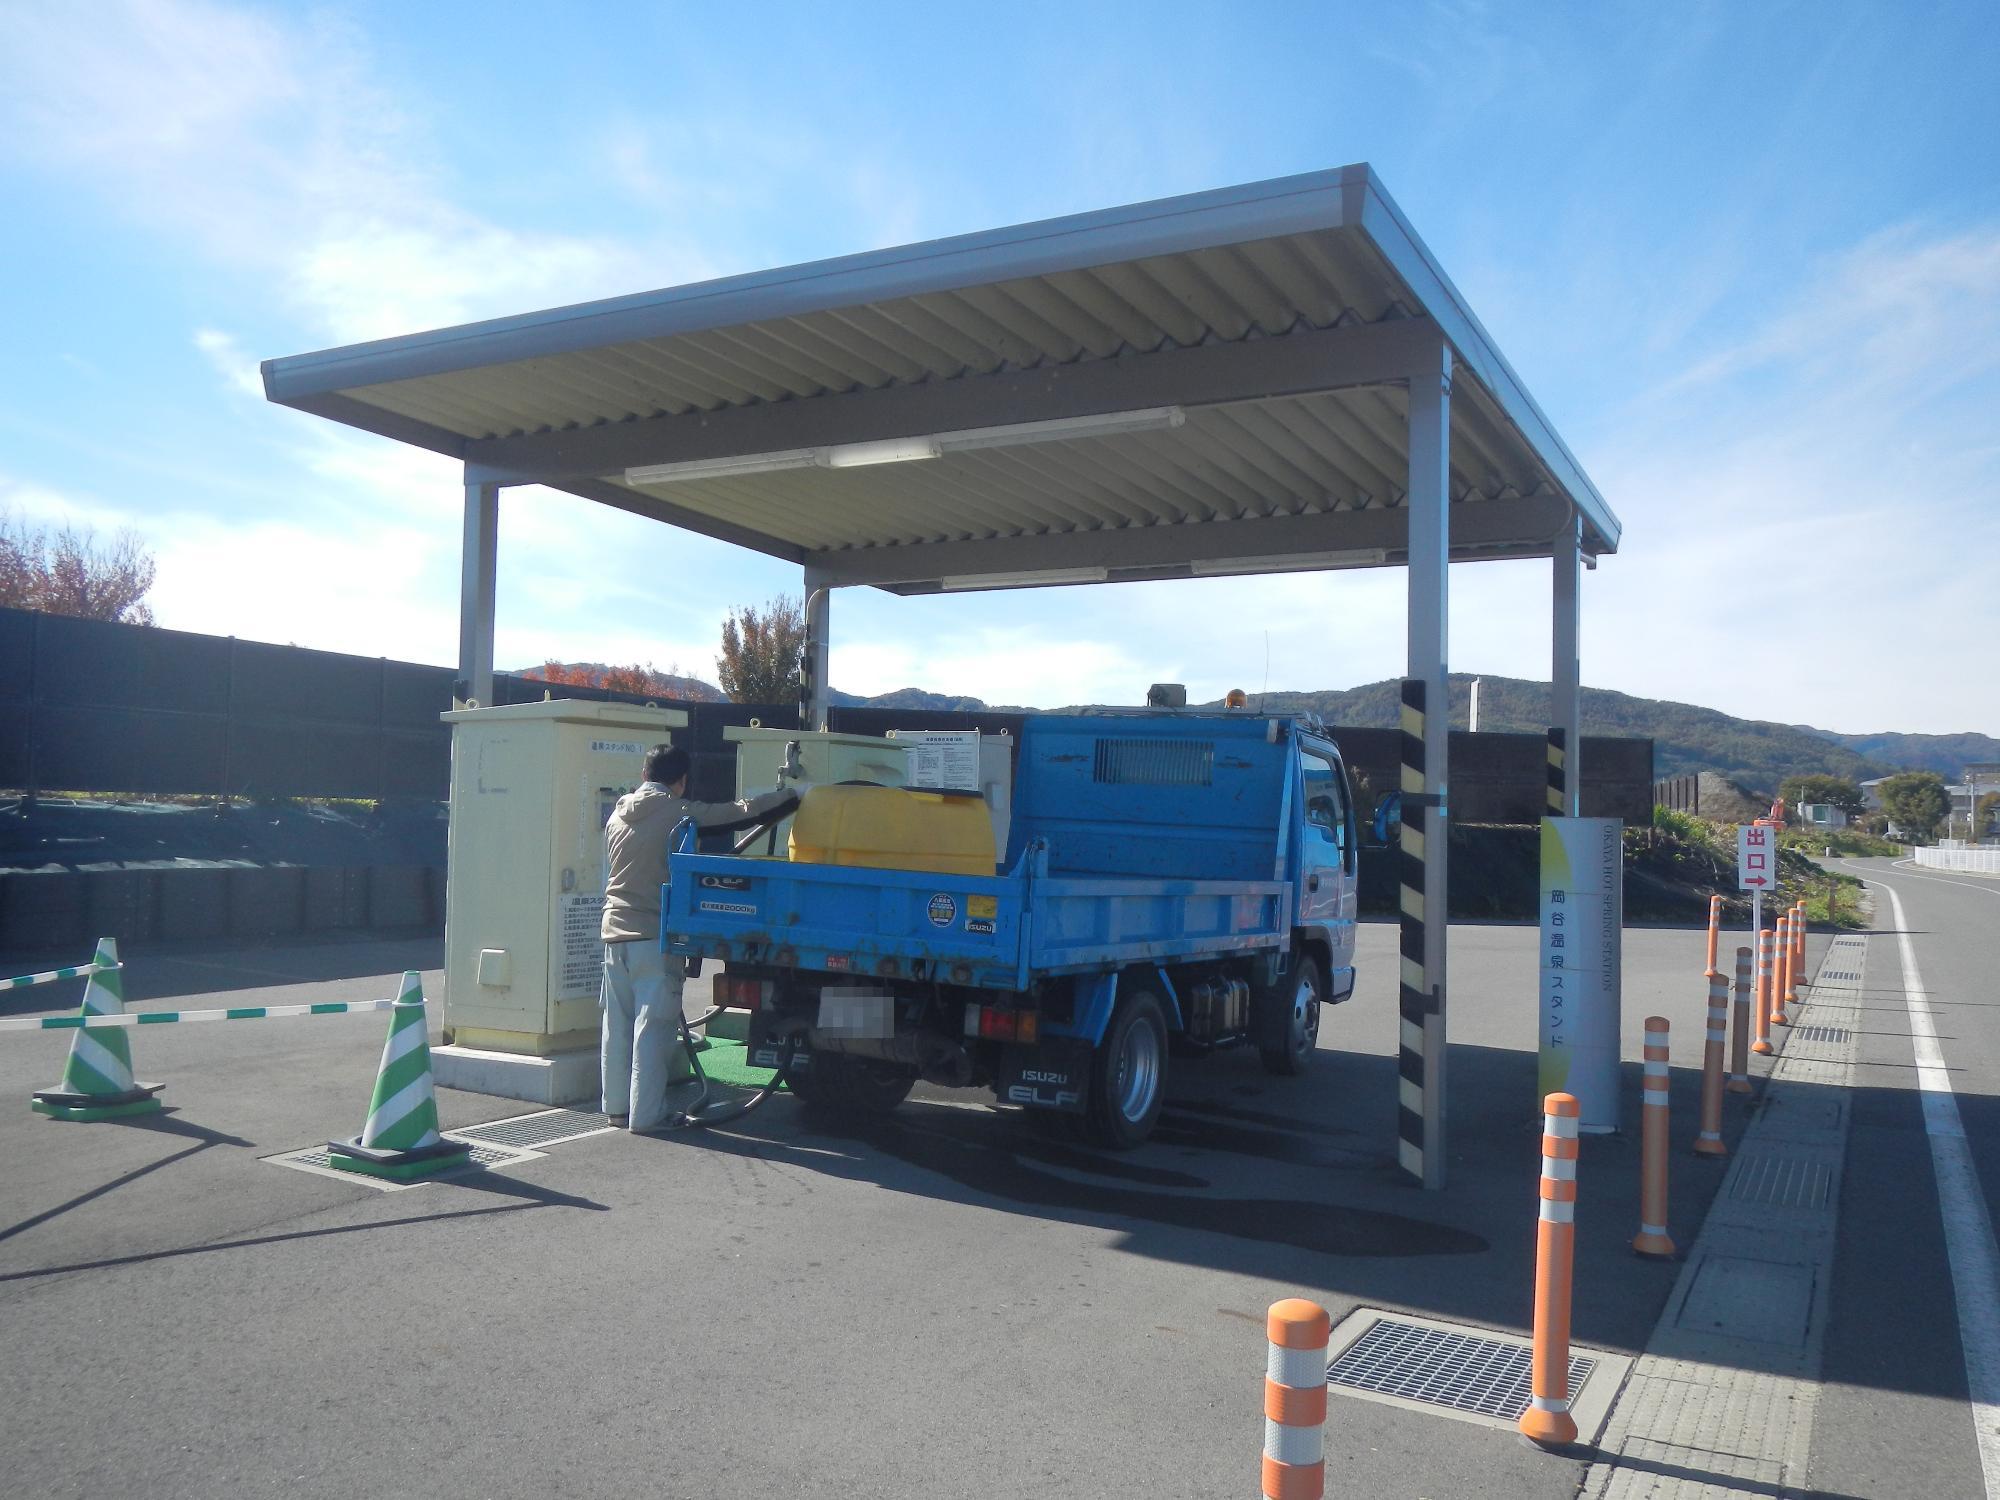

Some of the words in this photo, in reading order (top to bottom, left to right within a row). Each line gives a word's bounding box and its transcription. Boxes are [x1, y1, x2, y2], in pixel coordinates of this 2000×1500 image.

[1603, 825, 1614, 863] OKAYA
[1747, 829, 1765, 869] 出口
[1603, 866, 1613, 891] HOT
[968, 923, 993, 933] ISUZU
[1603, 894, 1613, 938] SPRING
[1551, 889, 1565, 1048] 岡谷温泉スタンド
[1602, 941, 1613, 992] STATION
[1008, 1084, 1079, 1106] ELF
[1021, 1069, 1068, 1084] ISUZU
